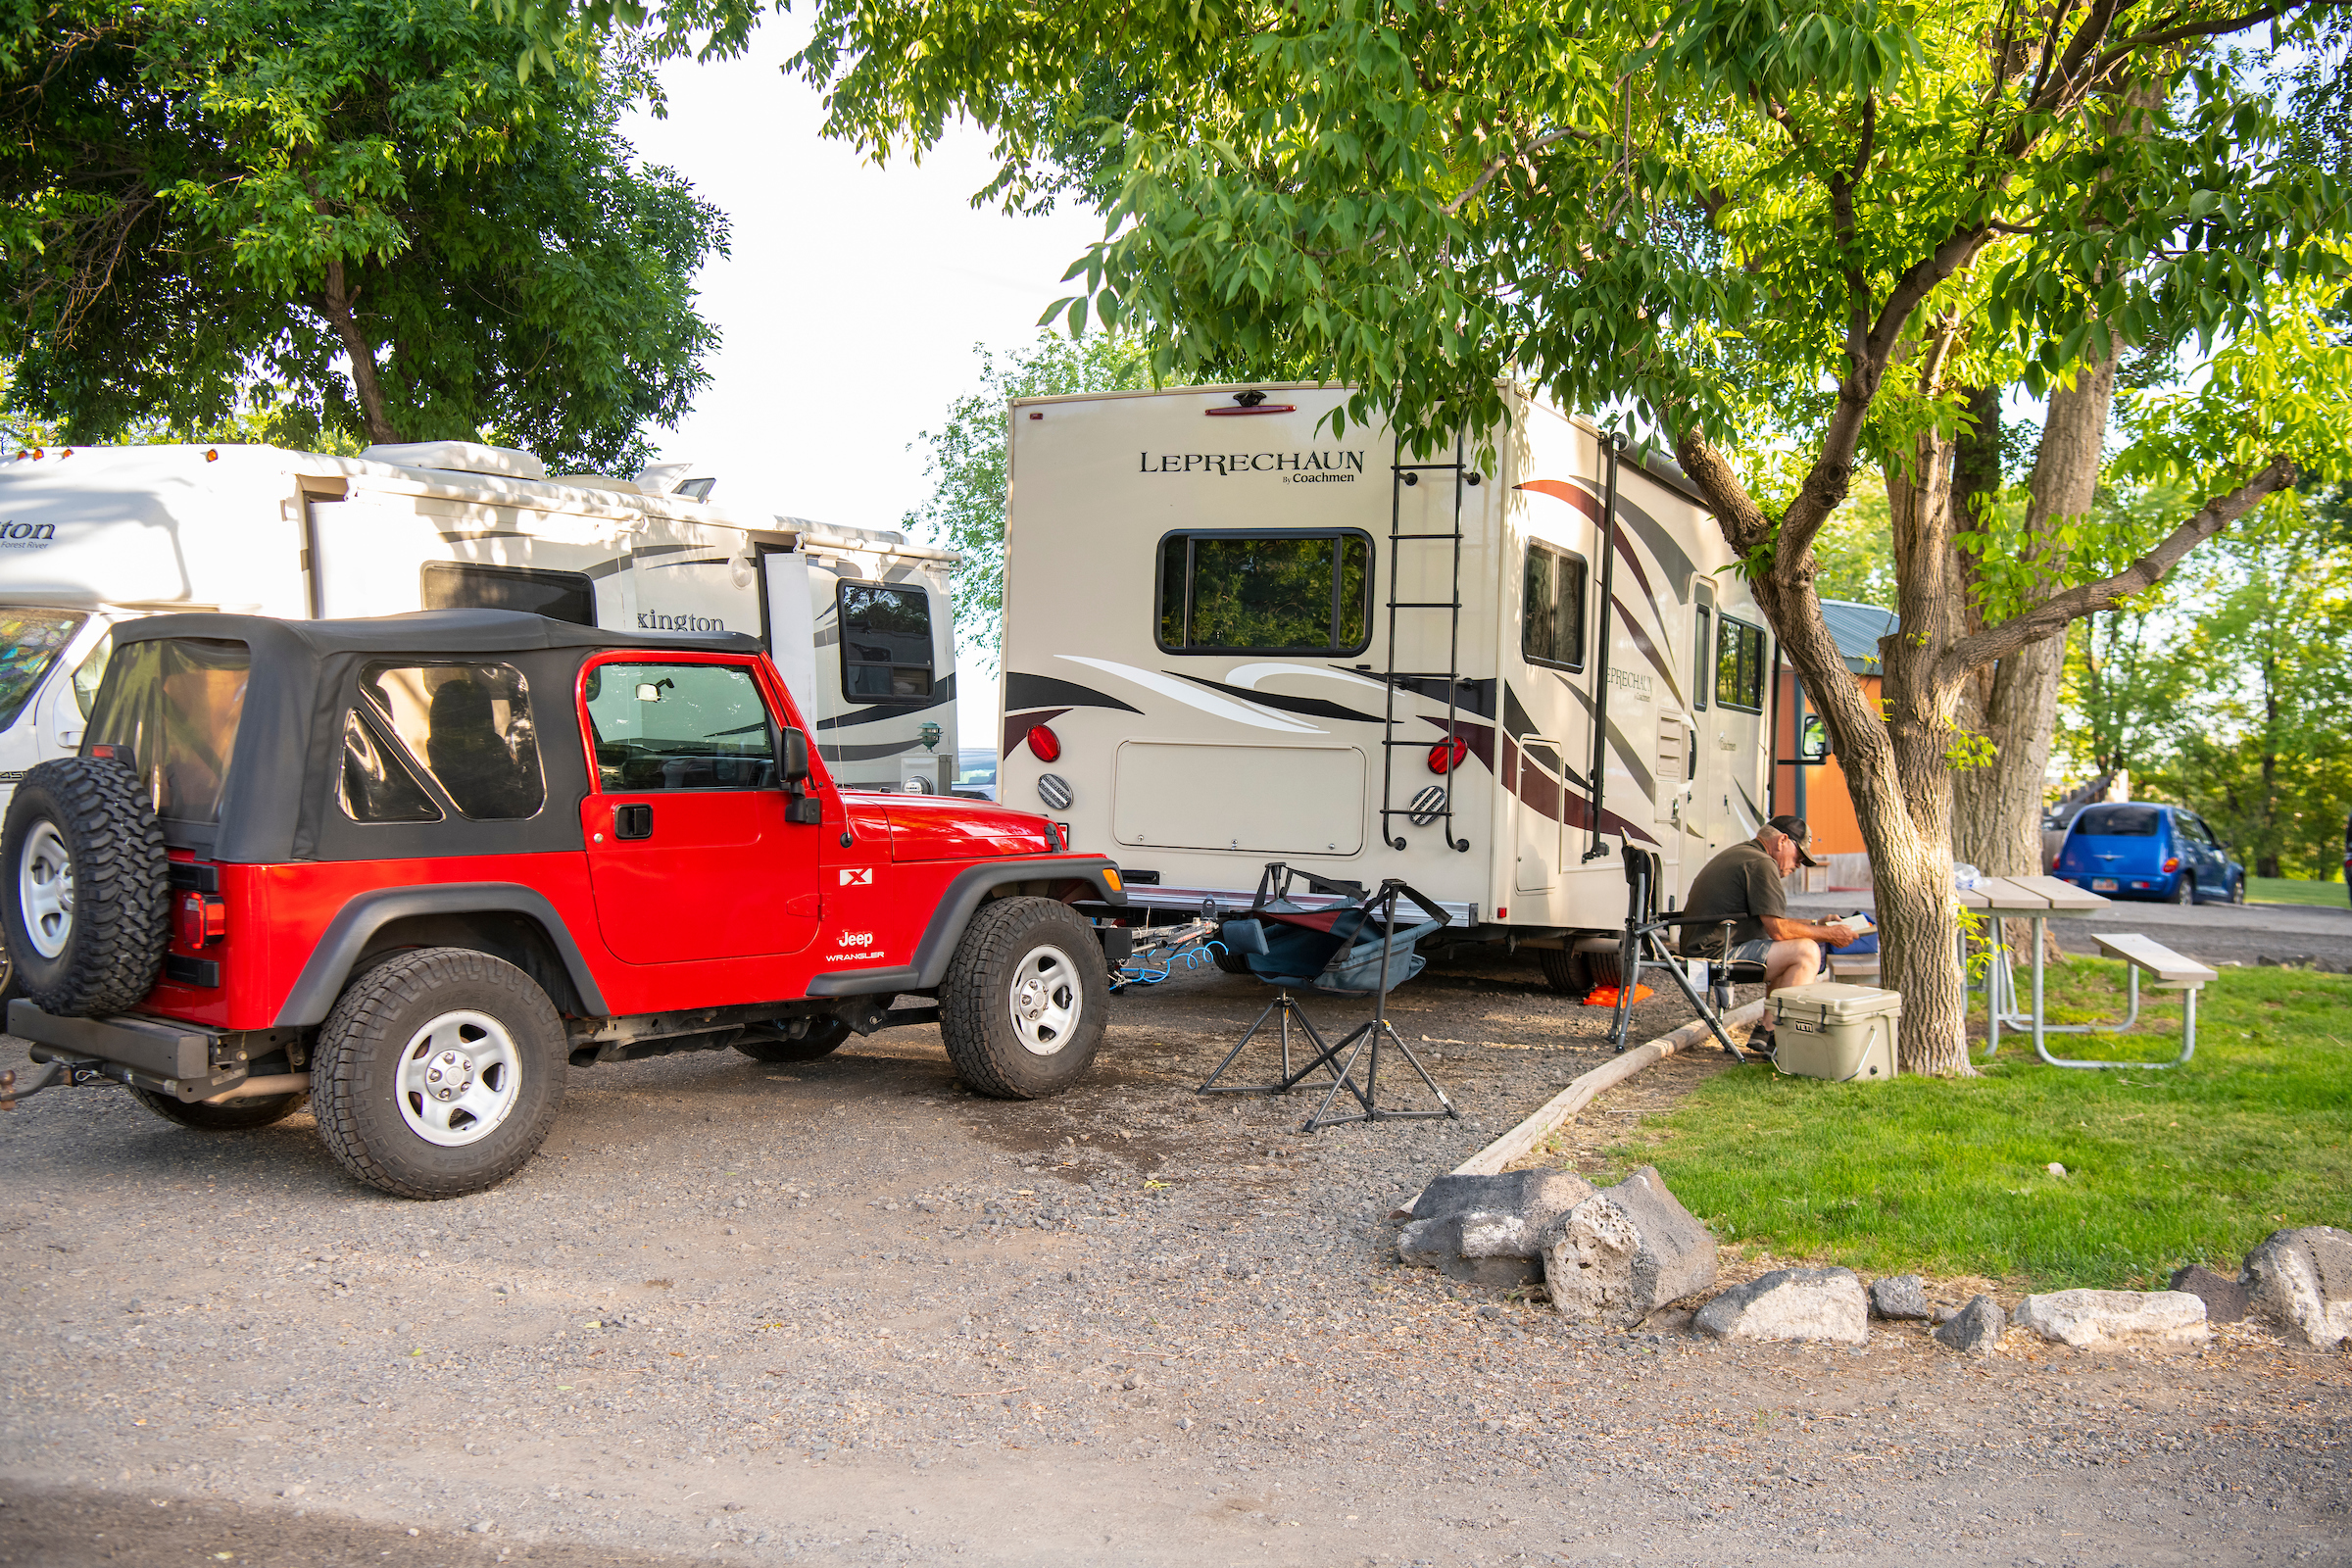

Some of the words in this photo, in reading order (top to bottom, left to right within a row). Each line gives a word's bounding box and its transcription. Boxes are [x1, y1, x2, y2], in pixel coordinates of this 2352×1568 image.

[1139, 450, 1365, 475] LEPRECHAUN
[1282, 475, 1292, 485] By
[1293, 472, 1354, 483] Coachmen
[0, 519, 56, 539] ton
[1607, 666, 1653, 695] EPRECHAUN
[838, 931, 874, 948] Jeep
[825, 951, 885, 962] WRANGLER
[1795, 1021, 1813, 1032] YETI
